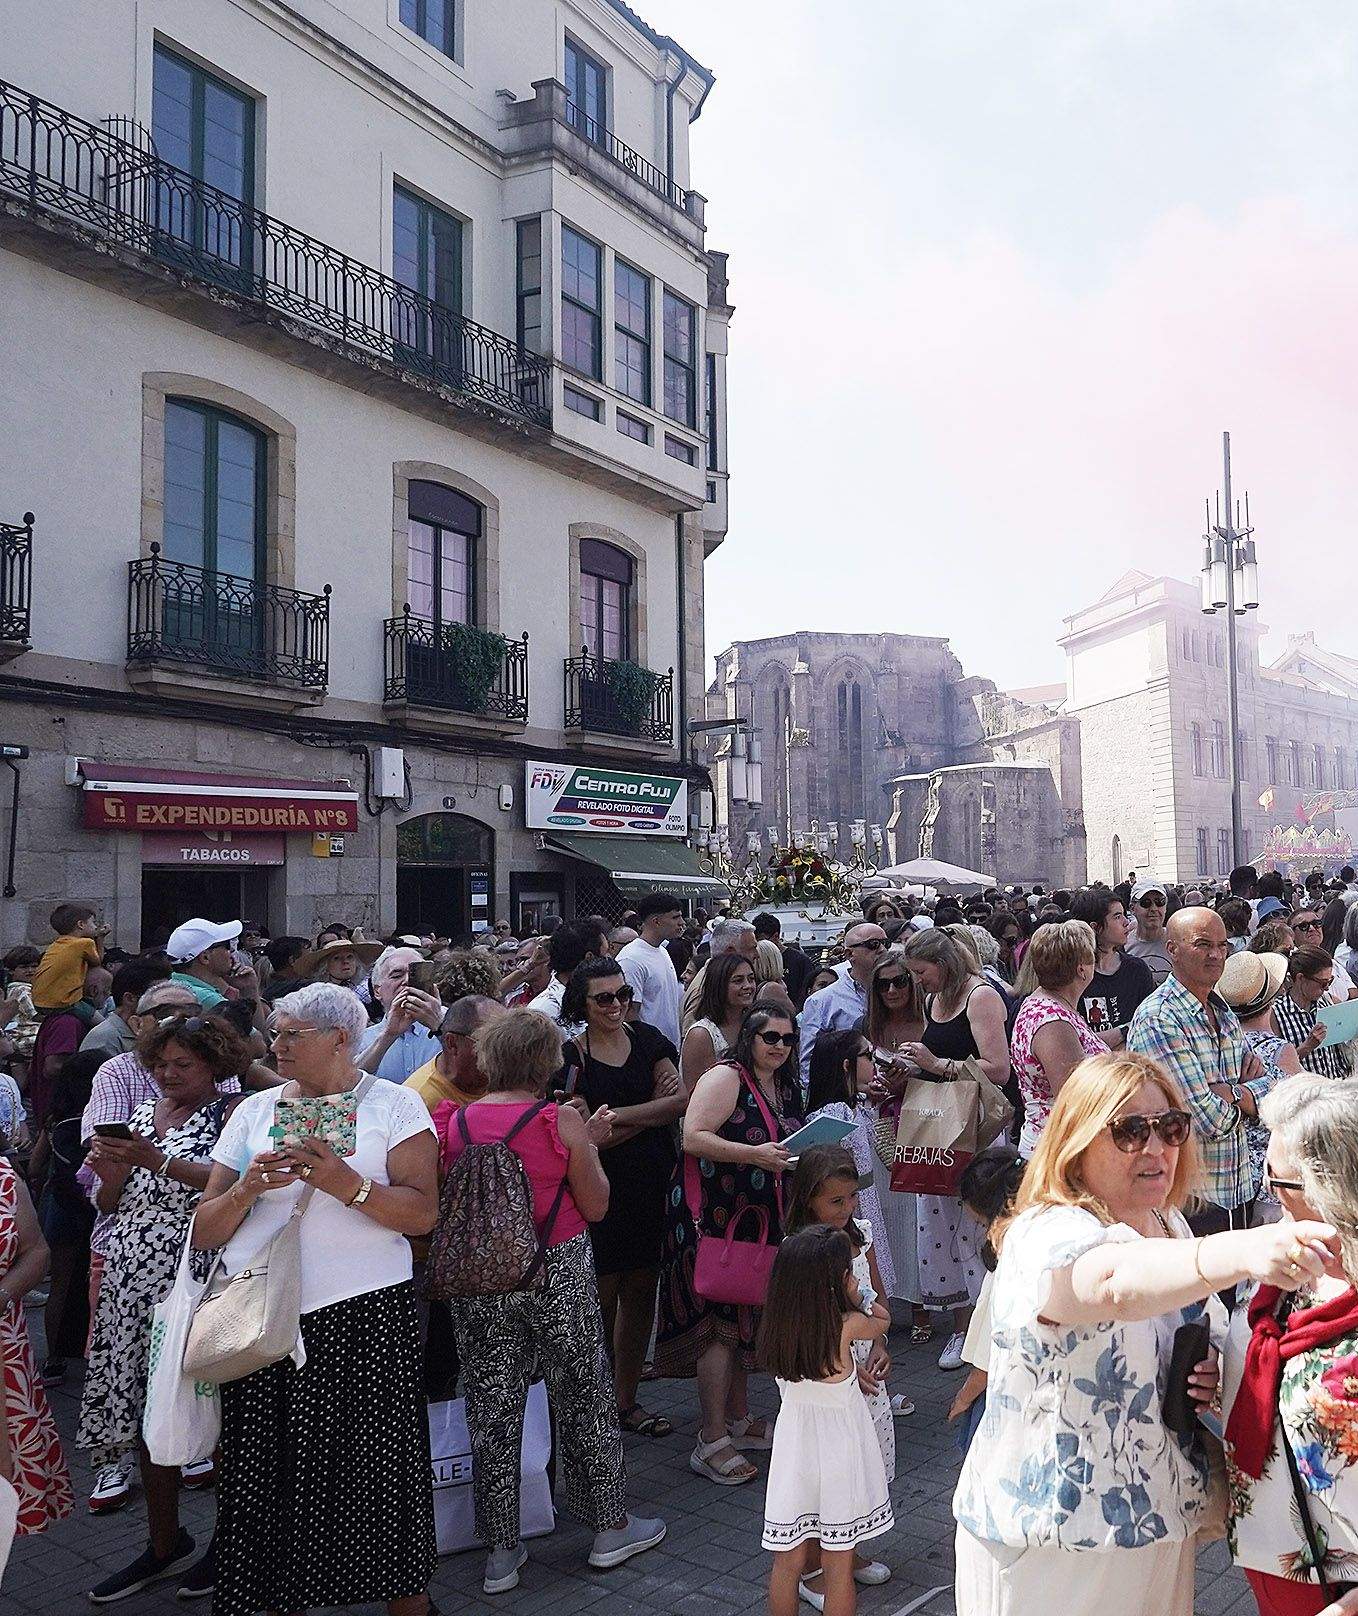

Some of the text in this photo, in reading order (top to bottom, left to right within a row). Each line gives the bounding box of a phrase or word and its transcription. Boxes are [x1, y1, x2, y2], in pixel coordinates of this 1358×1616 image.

[575, 776, 671, 798] CENTRO FUJI
[136, 803, 310, 826] EXPENDEDURÍA
[577, 800, 655, 815] REVELADO FOTO DIGITAL
[668, 815, 681, 823] FOTO
[665, 823, 686, 832] OLIMPIO
[180, 848, 250, 862] TABACOS
[893, 1145, 955, 1167] REBAJAS
